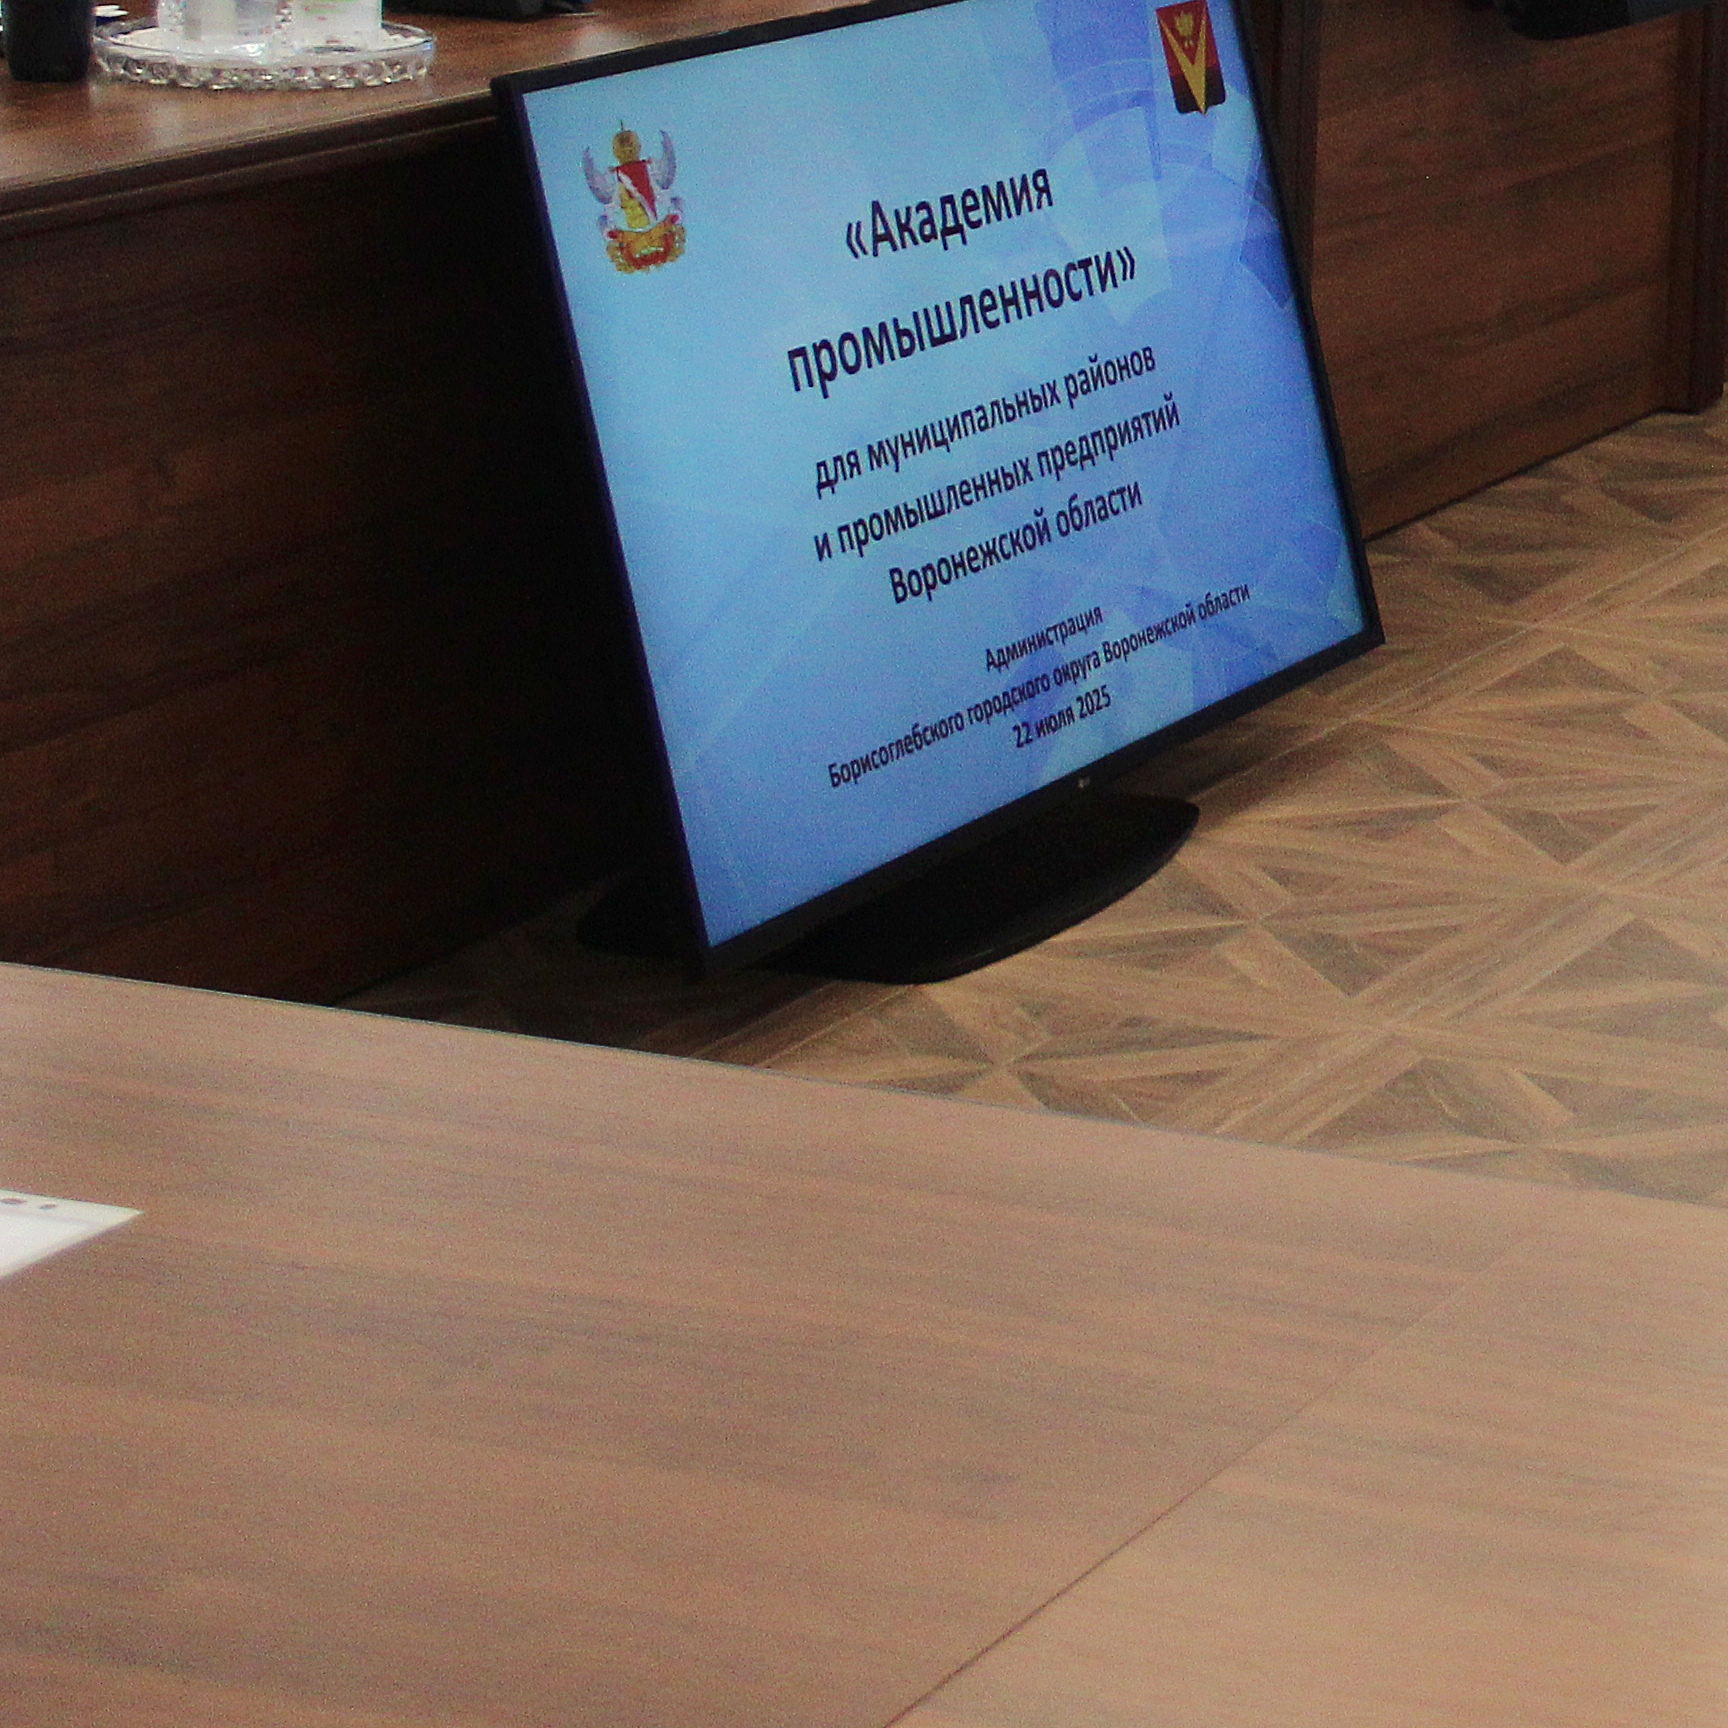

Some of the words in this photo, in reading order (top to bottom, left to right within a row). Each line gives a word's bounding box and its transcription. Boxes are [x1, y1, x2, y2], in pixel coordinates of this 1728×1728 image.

[846, 168, 1053, 259] «Академия
[787, 246, 1136, 400] промышленности»
[814, 533, 833, 562] и
[837, 456, 1034, 558] промышленных
[1036, 391, 1182, 481] предприятий
[815, 449, 862, 500] для
[867, 378, 1061, 473] муниципальных
[1063, 345, 1157, 409] районов
[889, 507, 1052, 604] Воронежской
[1055, 481, 1144, 538] области
[828, 710, 966, 789] Борисоглебского
[966, 670, 1051, 725] городского
[1052, 649, 1102, 687] округа
[1101, 602, 1197, 664] Воронежской
[1198, 582, 1251, 621] области
[985, 605, 1104, 672] Администрация
[1012, 723, 1034, 749] 22
[1034, 711, 1077, 738] июля
[1077, 684, 1112, 720] 2025
